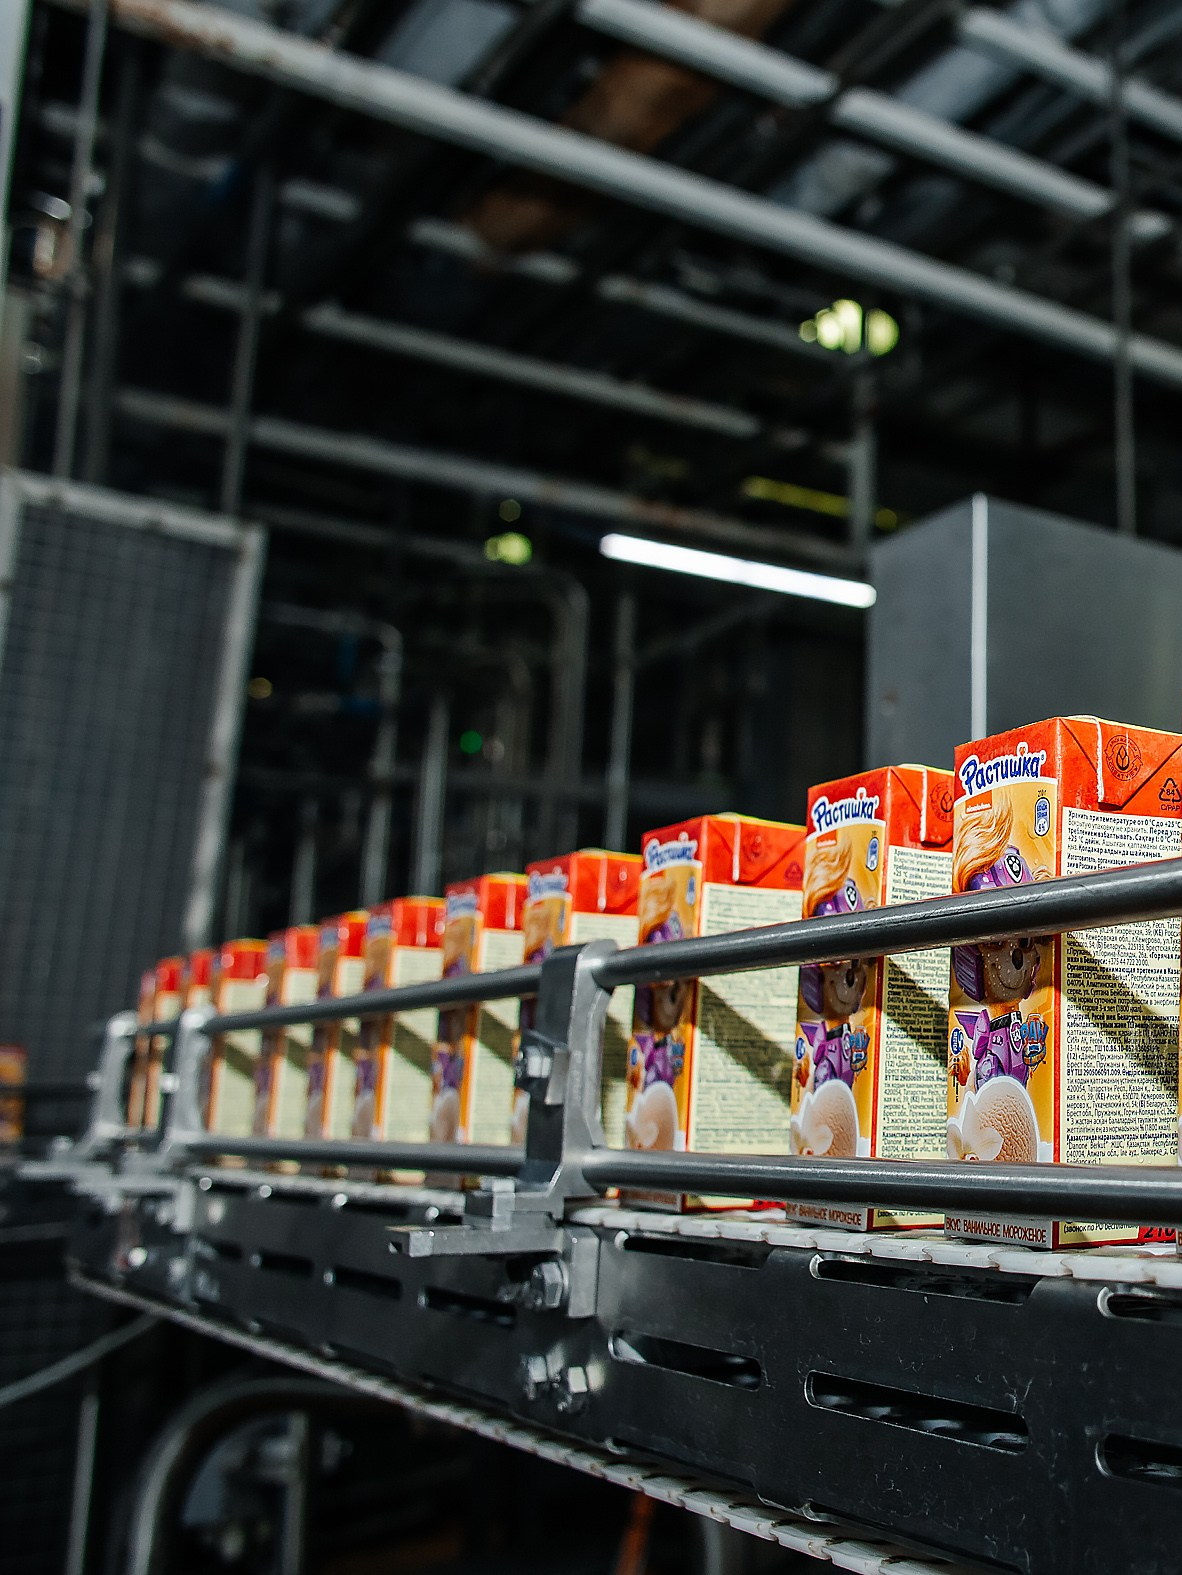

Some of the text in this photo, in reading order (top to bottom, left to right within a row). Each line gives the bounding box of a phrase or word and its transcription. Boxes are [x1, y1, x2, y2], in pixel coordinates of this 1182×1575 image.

[962, 757, 1041, 795] Растишка
[1166, 788, 1175, 796] 84
[1160, 803, 1181, 812] C/PAP
[814, 800, 875, 832] Растишка
[1144, 818, 1149, 826] 0
[1156, 820, 1164, 828] до
[1164, 820, 1175, 828] +25
[1149, 827, 1169, 836] Перед
[1020, 1020, 1049, 1043] PAW
[945, 1217, 1047, 1243] ВКУС ВАНИЛЬНОЕ МОРОЖЕНОЕ
